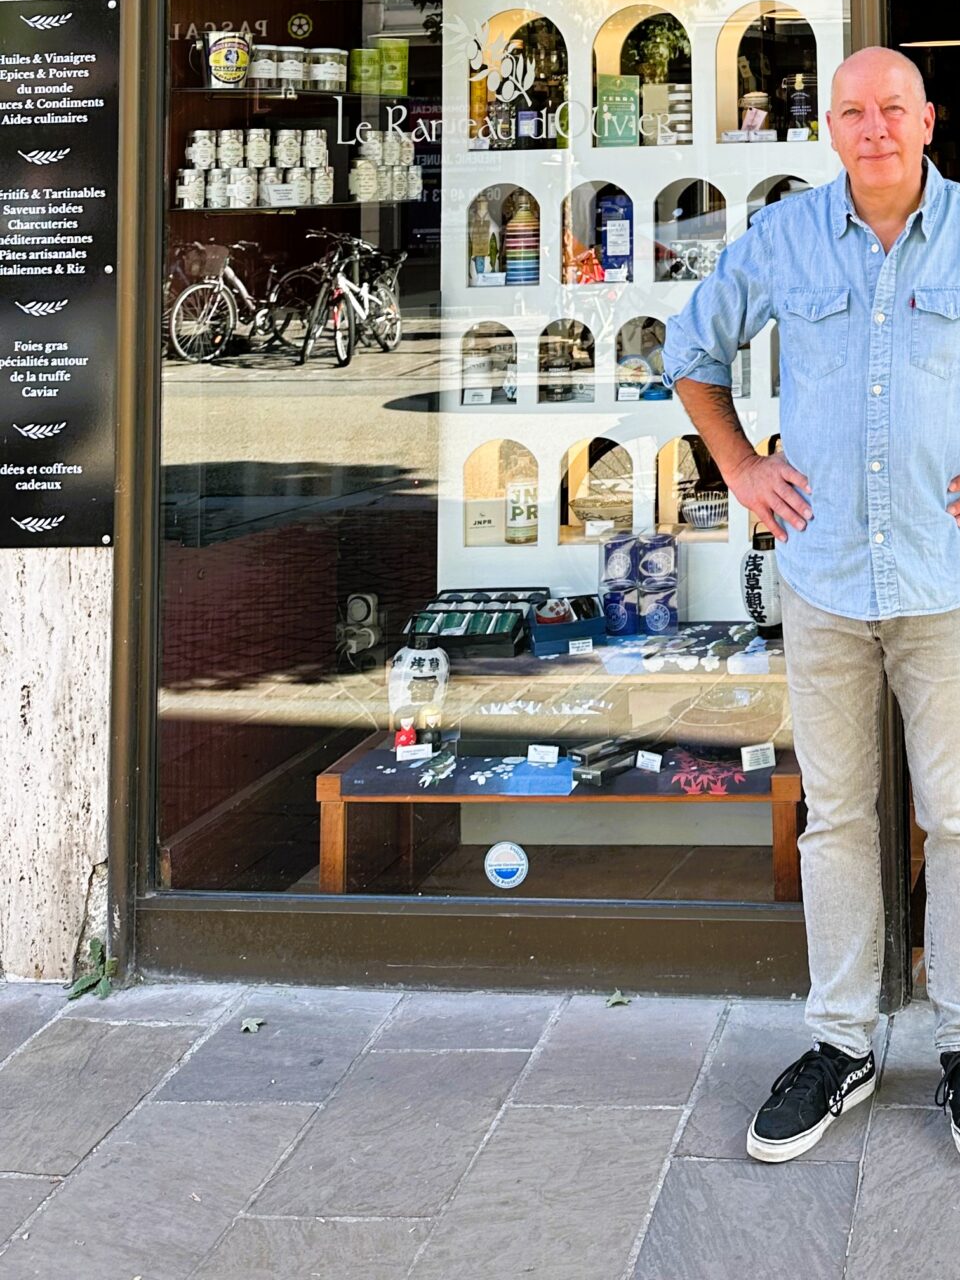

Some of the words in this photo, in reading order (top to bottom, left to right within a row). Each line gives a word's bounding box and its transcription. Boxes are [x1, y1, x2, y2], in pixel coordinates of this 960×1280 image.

[32, 54, 42, 64] &
[44, 52, 97, 65] Vinaigres
[0, 69, 35, 82] Epices
[36, 69, 47, 79] &
[48, 67, 90, 79] Poivres
[17, 83, 32, 94] du
[34, 82, 74, 94] monde
[24, 99, 35, 109] &
[36, 97, 105, 109] Condiments
[1, 114, 33, 125] Aides
[33, 112, 89, 124] culinaires
[333, 95, 373, 146] Le
[31, 189, 41, 199] &
[42, 187, 106, 199] Tartinables
[2, 205, 47, 215] Saveurs
[48, 203, 84, 214] iodées
[7, 218, 79, 230] Charcuteries
[0, 249, 27, 260] Pâtes
[28, 248, 88, 260] artisanales
[0, 264, 53, 276] italiennes
[54, 264, 65, 275] &
[66, 263, 86, 274] Riz
[14, 340, 43, 352] Foies
[44, 342, 69, 354] gras
[50, 357, 89, 366] autour
[9, 371, 25, 382] de
[26, 371, 37, 382] la
[38, 370, 72, 382] truffe
[21, 386, 60, 398] Caviar
[26, 465, 38, 475] et
[39, 463, 83, 475] coffrets
[15, 479, 62, 490] cadeaux
